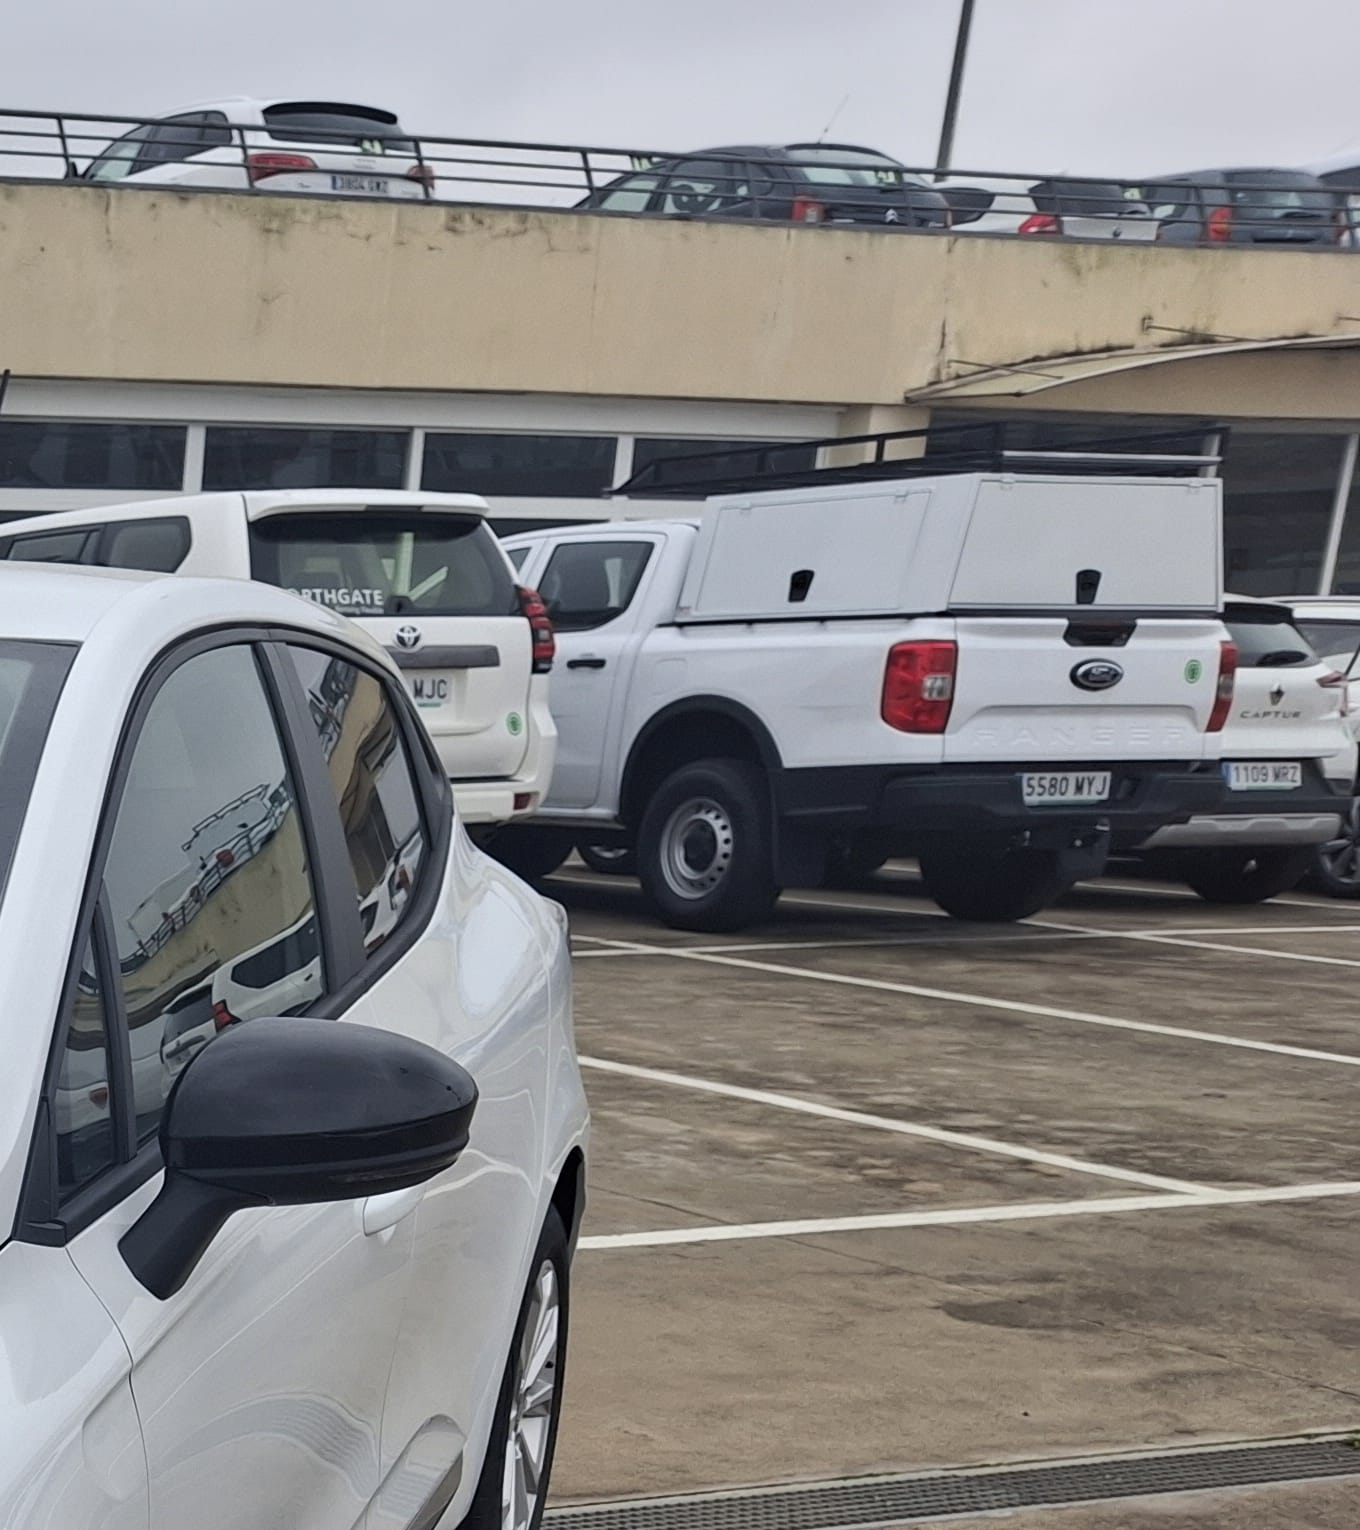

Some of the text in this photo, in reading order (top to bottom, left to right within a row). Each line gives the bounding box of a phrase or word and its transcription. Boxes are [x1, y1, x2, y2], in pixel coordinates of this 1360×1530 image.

[413, 679, 448, 699] MJC
[1240, 711, 1301, 719] CAPTUR
[973, 726, 1186, 746] RANGER
[1234, 765, 1299, 783] 1109 MRZ
[1025, 775, 1107, 797] 5580 MYJ
